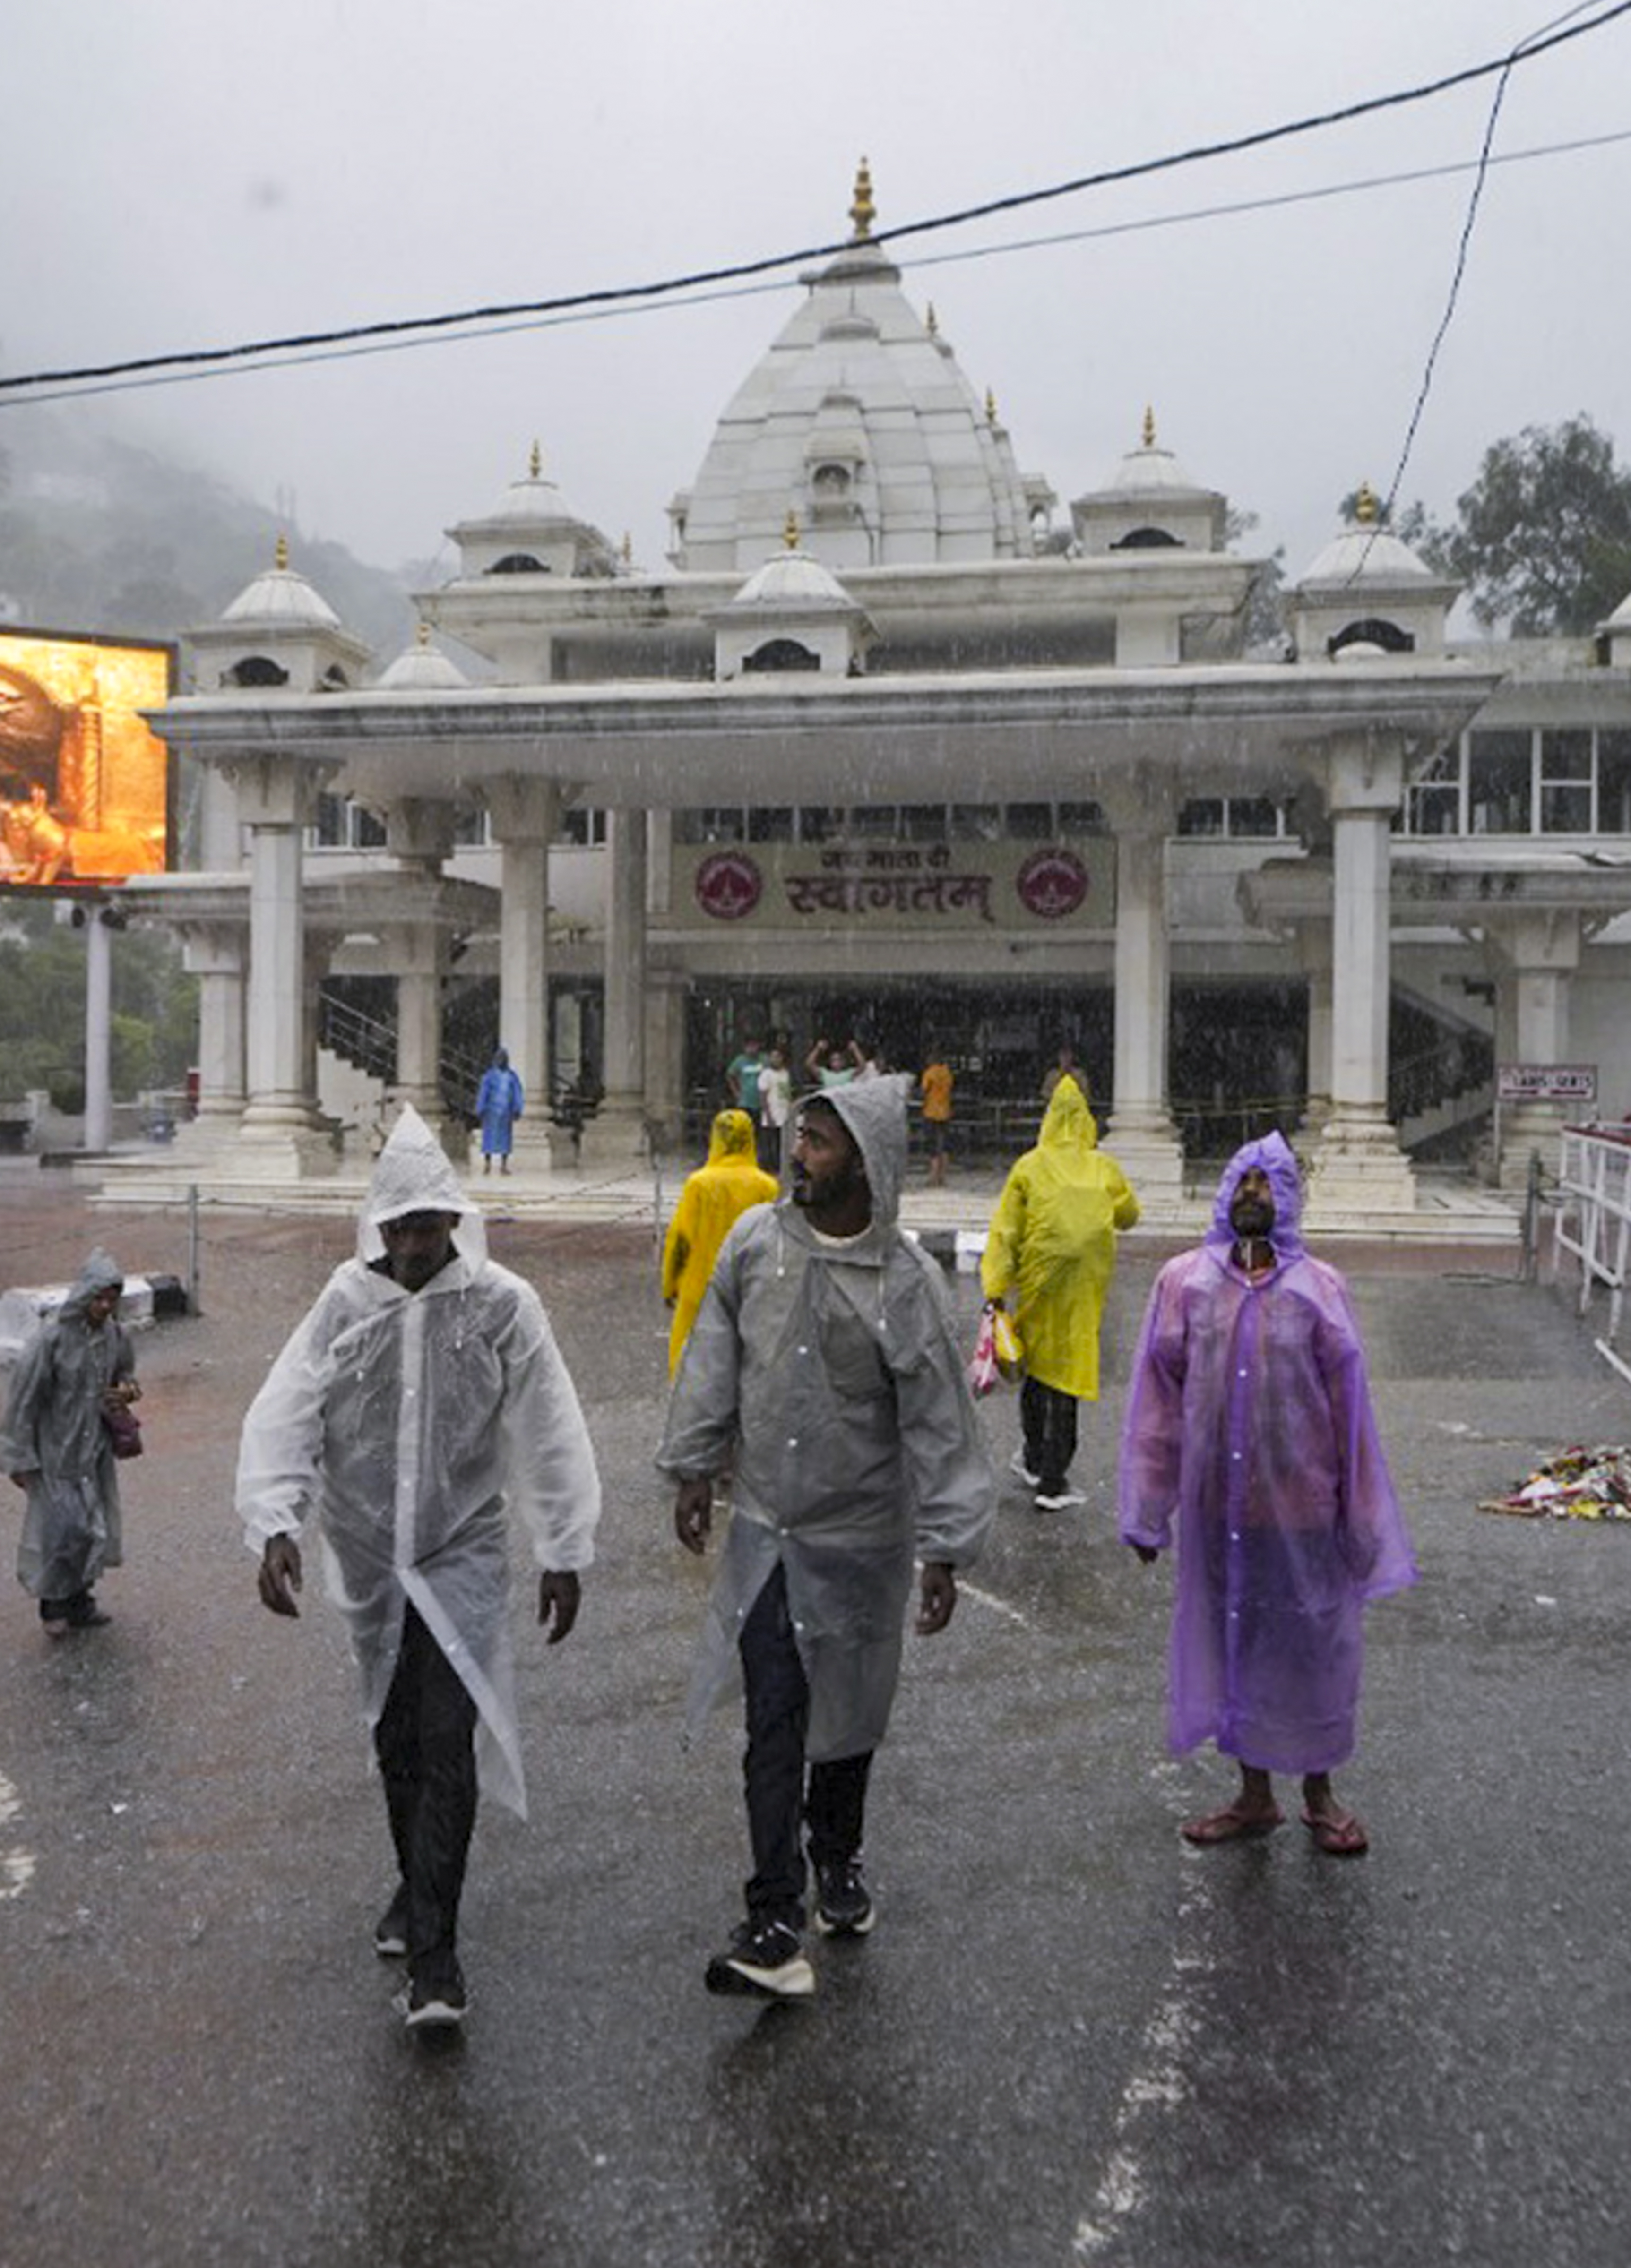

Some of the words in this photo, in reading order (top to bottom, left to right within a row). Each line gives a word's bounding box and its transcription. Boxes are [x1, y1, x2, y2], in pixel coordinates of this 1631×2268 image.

[866, 850, 921, 870] माता
[926, 844, 951, 869] दी
[784, 874, 995, 922] स्वागतम्
